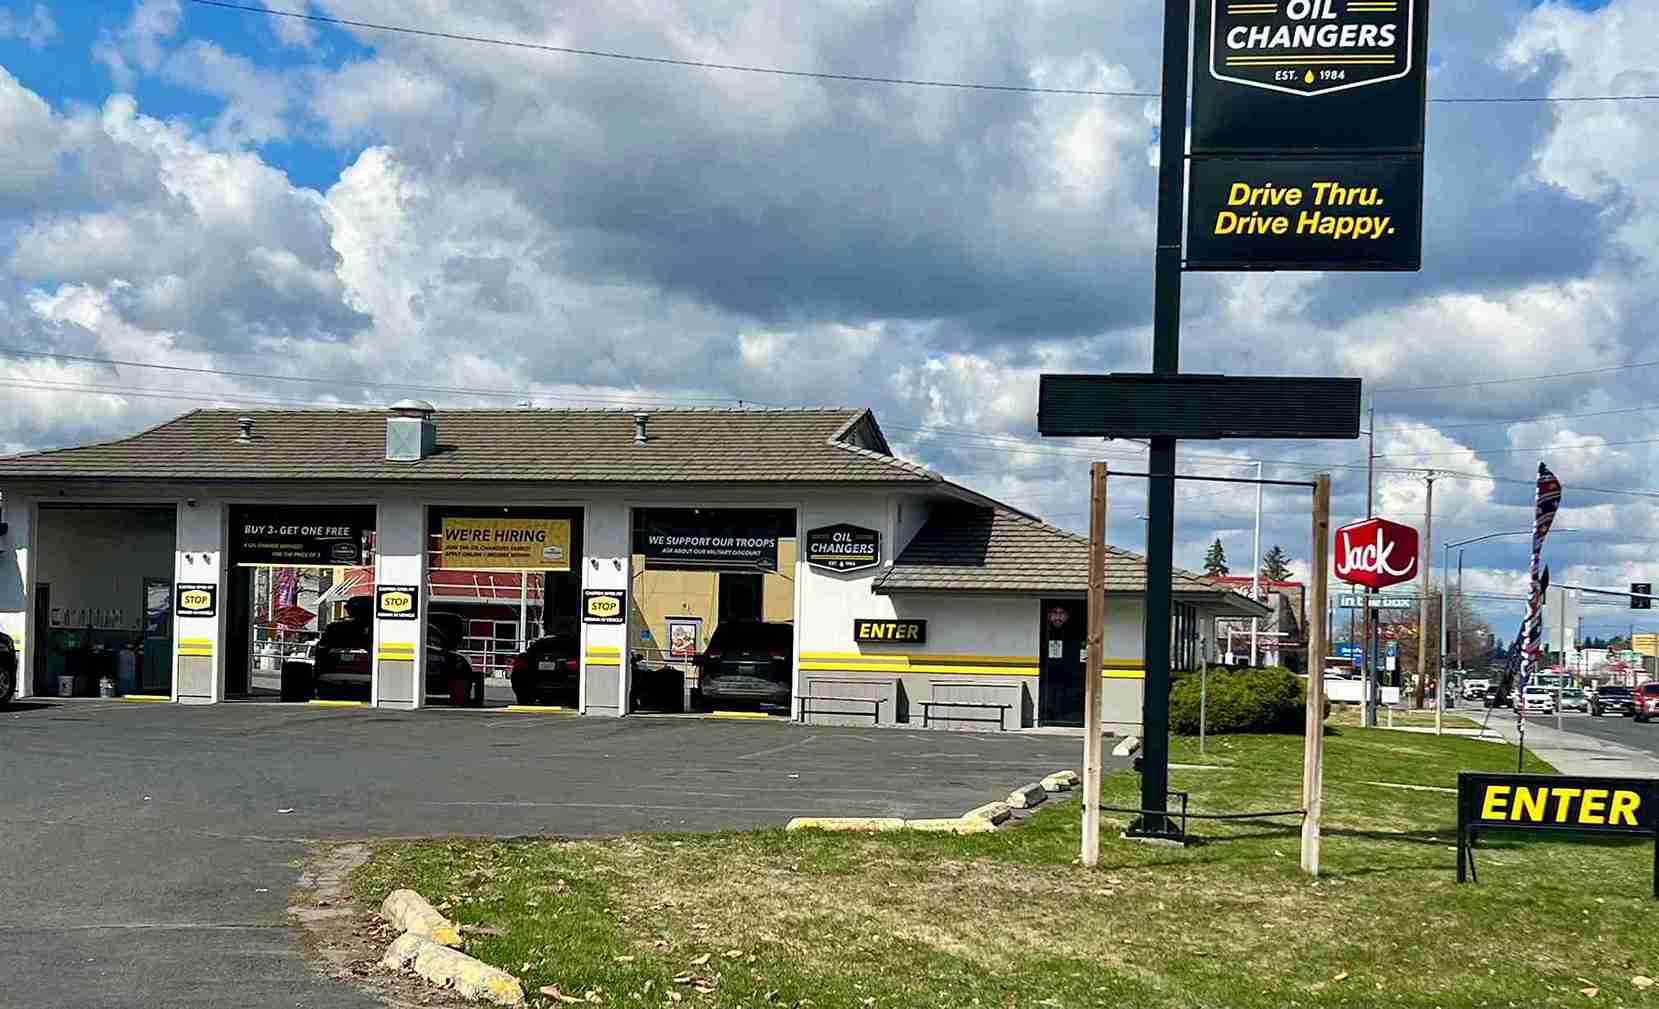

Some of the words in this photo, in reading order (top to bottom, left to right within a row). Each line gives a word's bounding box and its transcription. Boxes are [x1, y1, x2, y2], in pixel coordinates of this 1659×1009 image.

[1286, 0, 1337, 20] OIL
[1226, 24, 1396, 49] CHANGERS
[1275, 71, 1298, 81] EST.
[1319, 70, 1345, 80] 1984
[1228, 182, 1303, 206] Drive
[1311, 182, 1383, 206] Thru.
[1214, 211, 1288, 235] Drive
[1296, 211, 1395, 240] Happy.
[244, 524, 266, 535] BUY
[280, 525, 300, 535] GET
[301, 526, 325, 536] ONE
[325, 526, 350, 536] FREE
[446, 528, 491, 542] WE'RE
[495, 529, 546, 543] HIRING
[649, 536, 665, 545] WE
[666, 536, 711, 546] SUPPORT
[712, 537, 734, 547] OUR
[735, 538, 775, 548] TROOPS
[833, 532, 852, 542] OIL
[811, 543, 874, 553] CHANGERS
[1337, 528, 1414, 575] Jack
[184, 596, 208, 604] STOP
[384, 598, 408, 606] STOP
[591, 602, 616, 610] STOP
[859, 623, 919, 640] ENTER
[1481, 785, 1641, 826] ENTER
